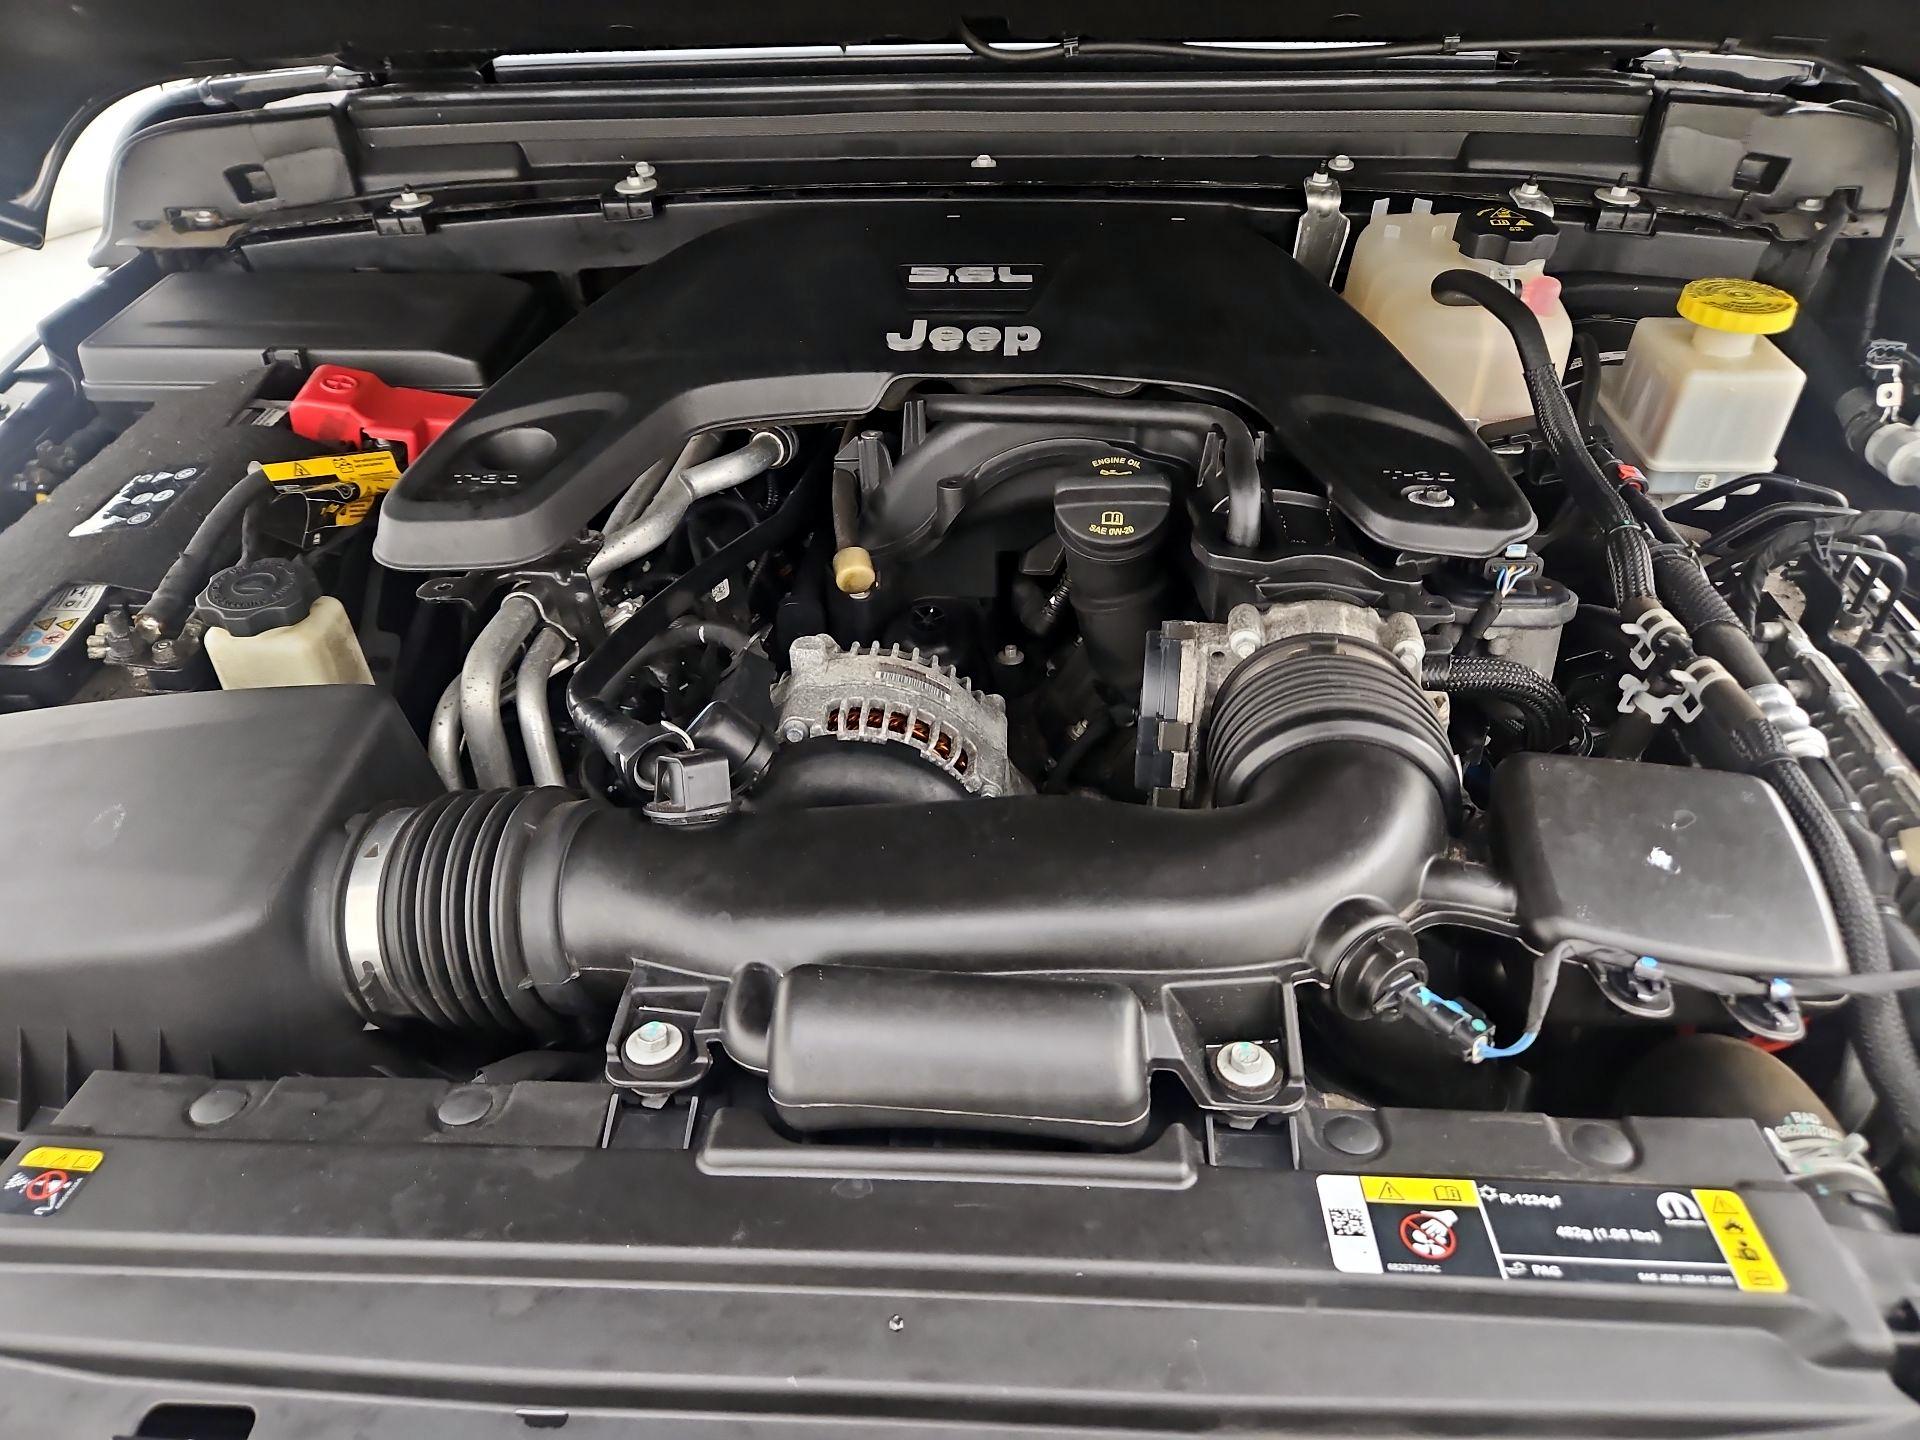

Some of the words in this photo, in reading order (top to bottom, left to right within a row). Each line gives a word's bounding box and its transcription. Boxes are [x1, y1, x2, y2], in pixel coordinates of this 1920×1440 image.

[908, 266, 1033, 283] 3.6L
[886, 319, 1042, 357] Jeep
[1092, 457, 1126, 467] ENGINE
[1127, 459, 1140, 469] OIL
[1089, 524, 1107, 535] SAE
[1108, 526, 1134, 536] 0W-20
